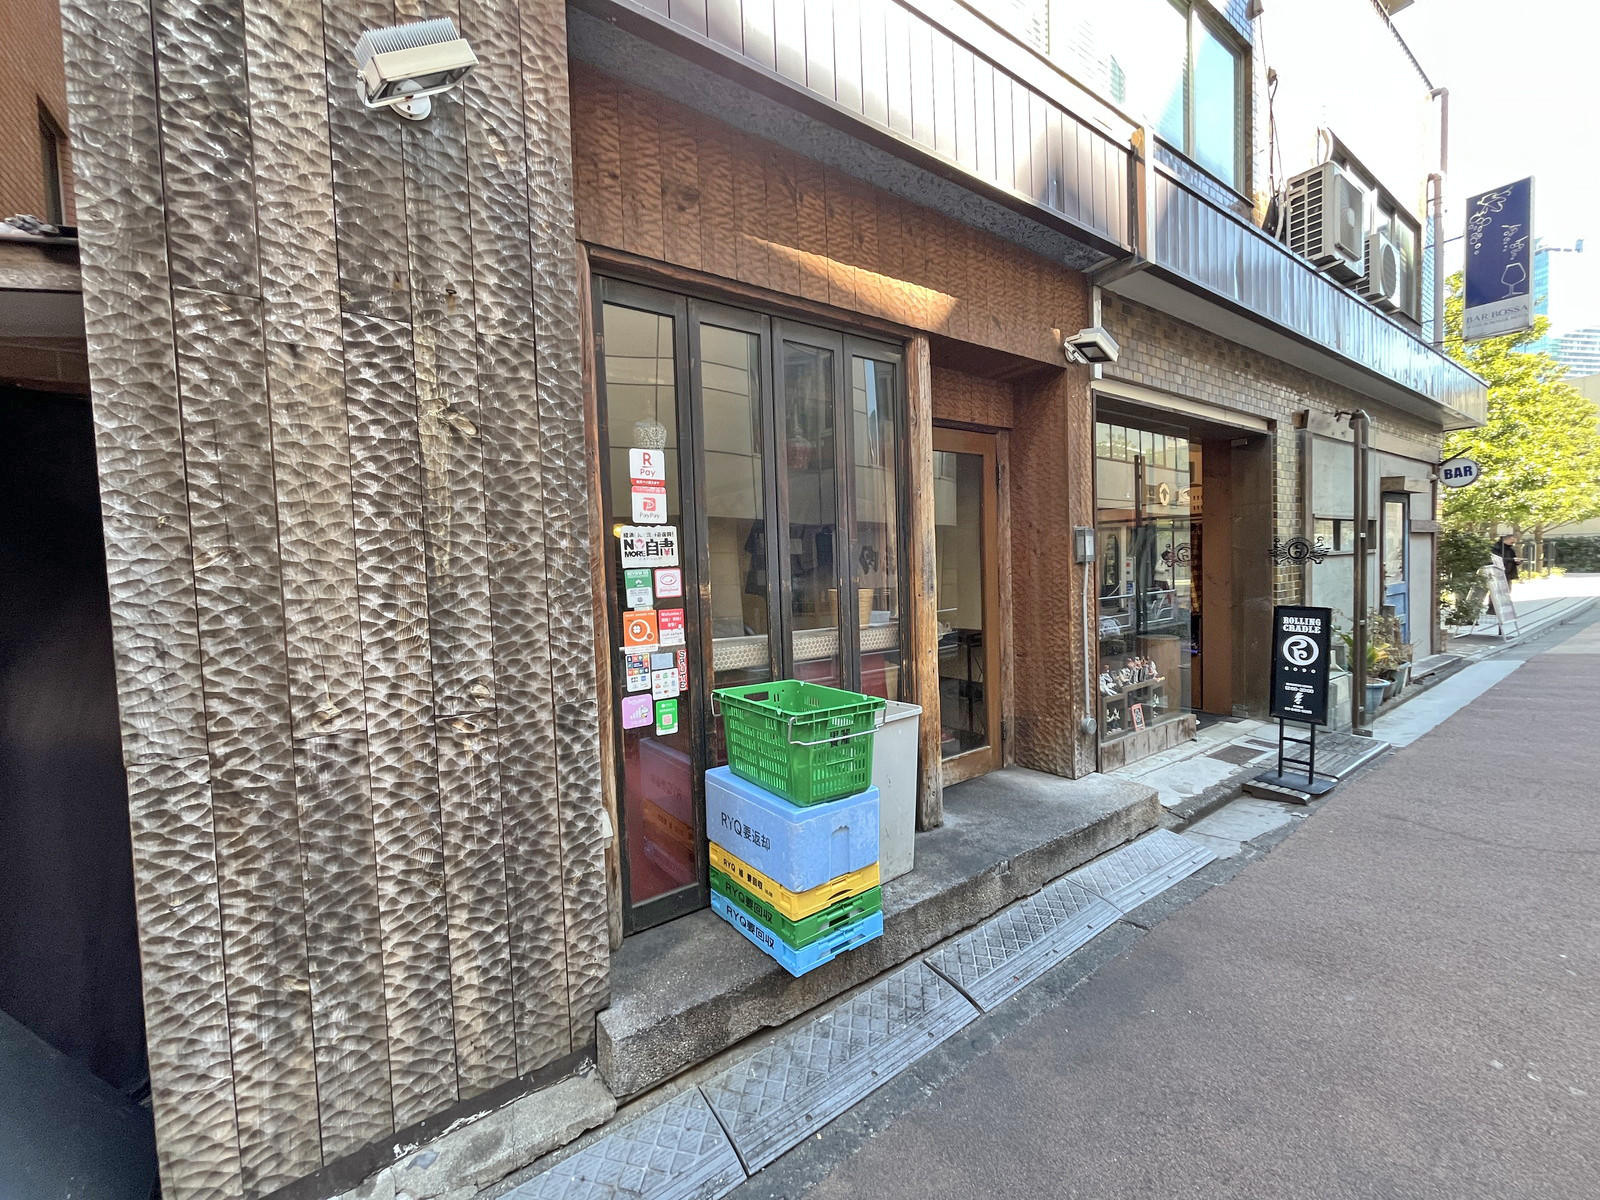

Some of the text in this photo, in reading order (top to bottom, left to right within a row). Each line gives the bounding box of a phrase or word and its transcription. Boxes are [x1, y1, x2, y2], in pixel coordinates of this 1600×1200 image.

[1467, 313, 1488, 324] BAR
[1491, 304, 1528, 318] BOSSA
[642, 452, 652, 465] R
[640, 468, 656, 477] Pay
[1443, 465, 1473, 480] BAR
[624, 550, 646, 558] MORE
[1282, 616, 1322, 626] ROLLING
[1282, 624, 1322, 634] CRADLE
[721, 811, 771, 851] RYQ要返却
[723, 858, 736, 873] RYQ
[725, 882, 773, 924] RYQ要回収
[726, 905, 775, 950] RYQ要回収
